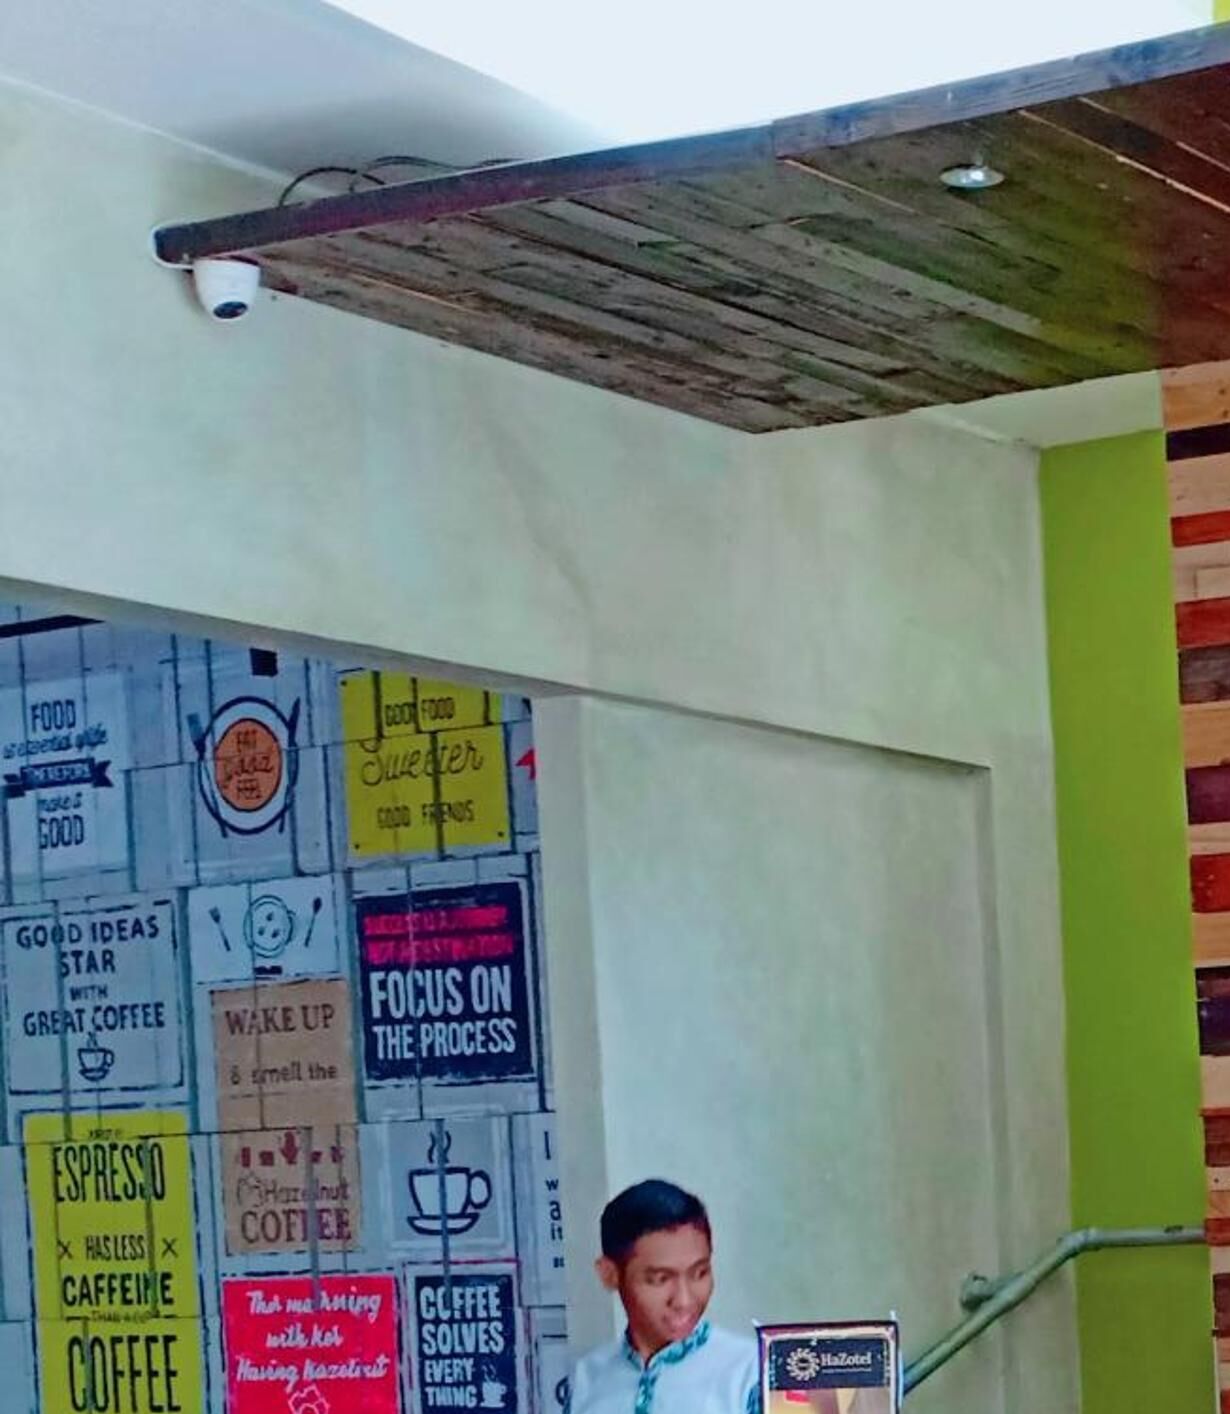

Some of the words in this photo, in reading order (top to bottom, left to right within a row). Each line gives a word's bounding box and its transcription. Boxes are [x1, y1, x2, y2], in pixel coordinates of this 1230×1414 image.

[31, 699, 76, 732] FOOD
[422, 697, 455, 720] FOOD
[360, 739, 483, 787] Sweeter
[38, 814, 84, 849] GOOD
[16, 924, 82, 950] GOOD
[91, 915, 160, 944] IDEAS
[59, 949, 116, 978] STAR
[69, 985, 108, 1001] WITH
[369, 967, 464, 1019] FOCUS
[470, 965, 512, 1013] ON
[23, 1008, 86, 1037] GREAT
[92, 1002, 166, 1032] COFFEE
[225, 1007, 296, 1035] WAKE
[301, 1003, 335, 1030] UP
[372, 1024, 415, 1060] THE
[420, 1018, 517, 1058] PROCESS
[251, 1061, 302, 1084] smell
[308, 1062, 338, 1080] the
[53, 1142, 166, 1203] ESPRESSO
[241, 1207, 352, 1244] COFFEE
[85, 1235, 112, 1261] HAS
[114, 1234, 146, 1261] LESS
[62, 1272, 174, 1307] CAFFEINE
[420, 1286, 502, 1320] COFFEE
[266, 1324, 308, 1349] with
[422, 1321, 505, 1355] SOLVES
[68, 1334, 182, 1414] COFFEE
[424, 1357, 474, 1383] EVERY
[821, 1352, 872, 1366] HaZotel
[425, 1384, 477, 1408] THING
